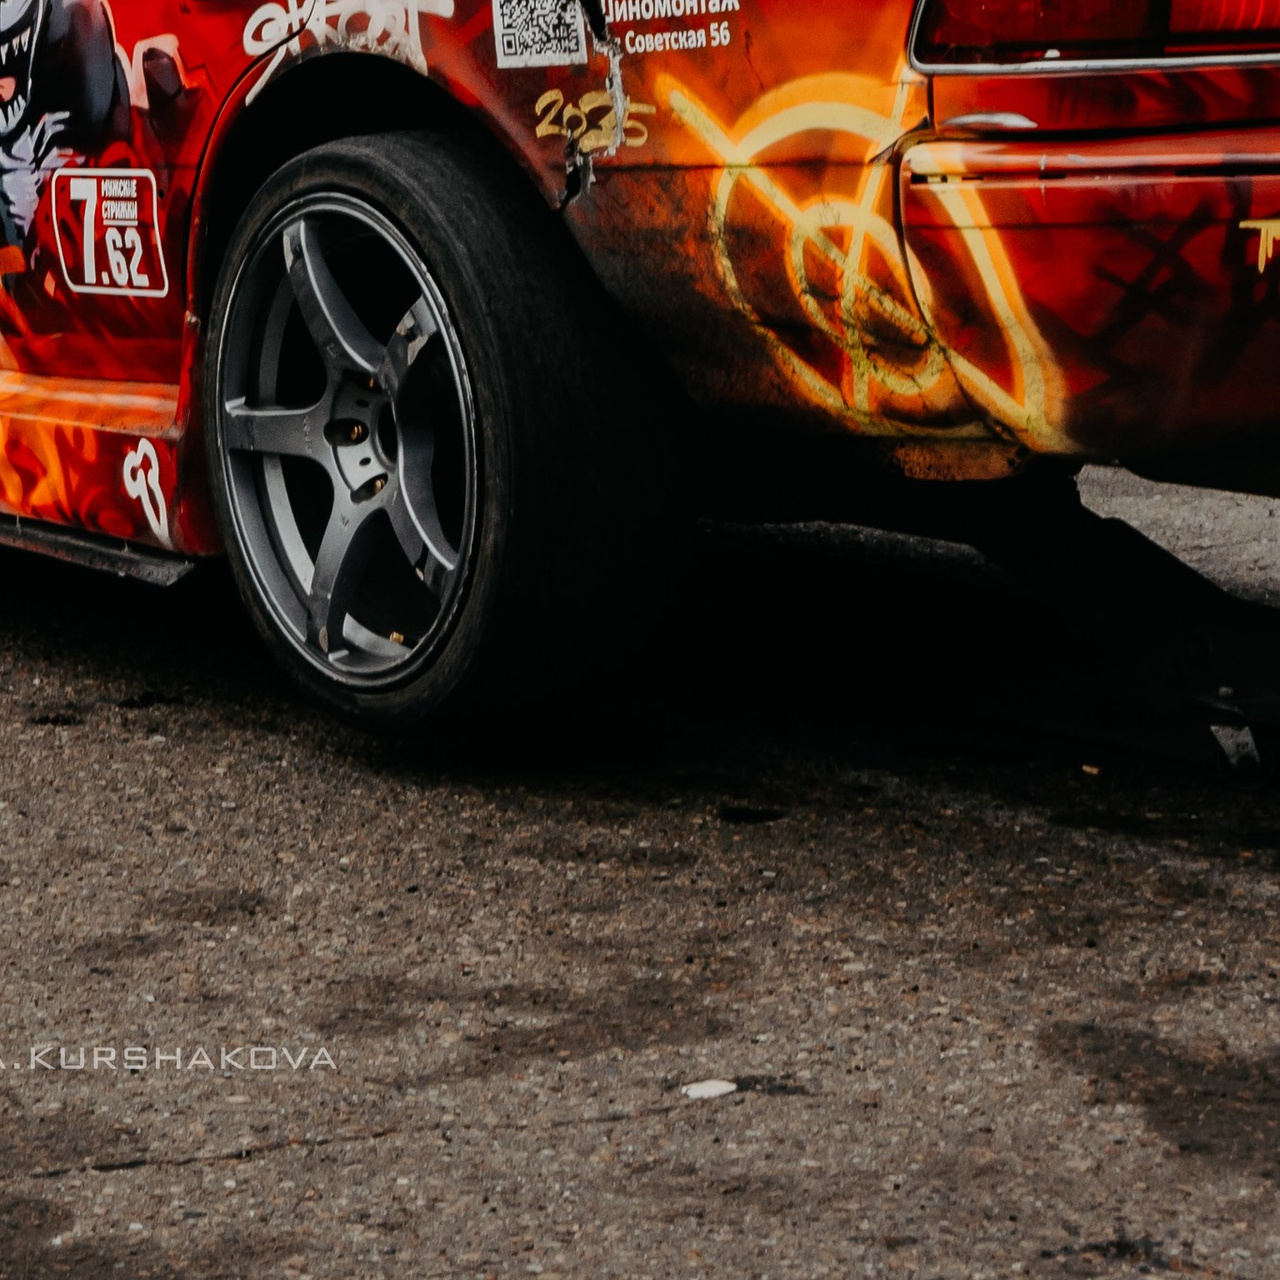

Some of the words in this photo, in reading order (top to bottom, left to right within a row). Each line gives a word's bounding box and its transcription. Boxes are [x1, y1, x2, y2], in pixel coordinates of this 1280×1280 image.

[625, 28, 706, 55] Советская
[709, 21, 730, 46] 56
[102, 200, 138, 220] СТРИЖКИ
